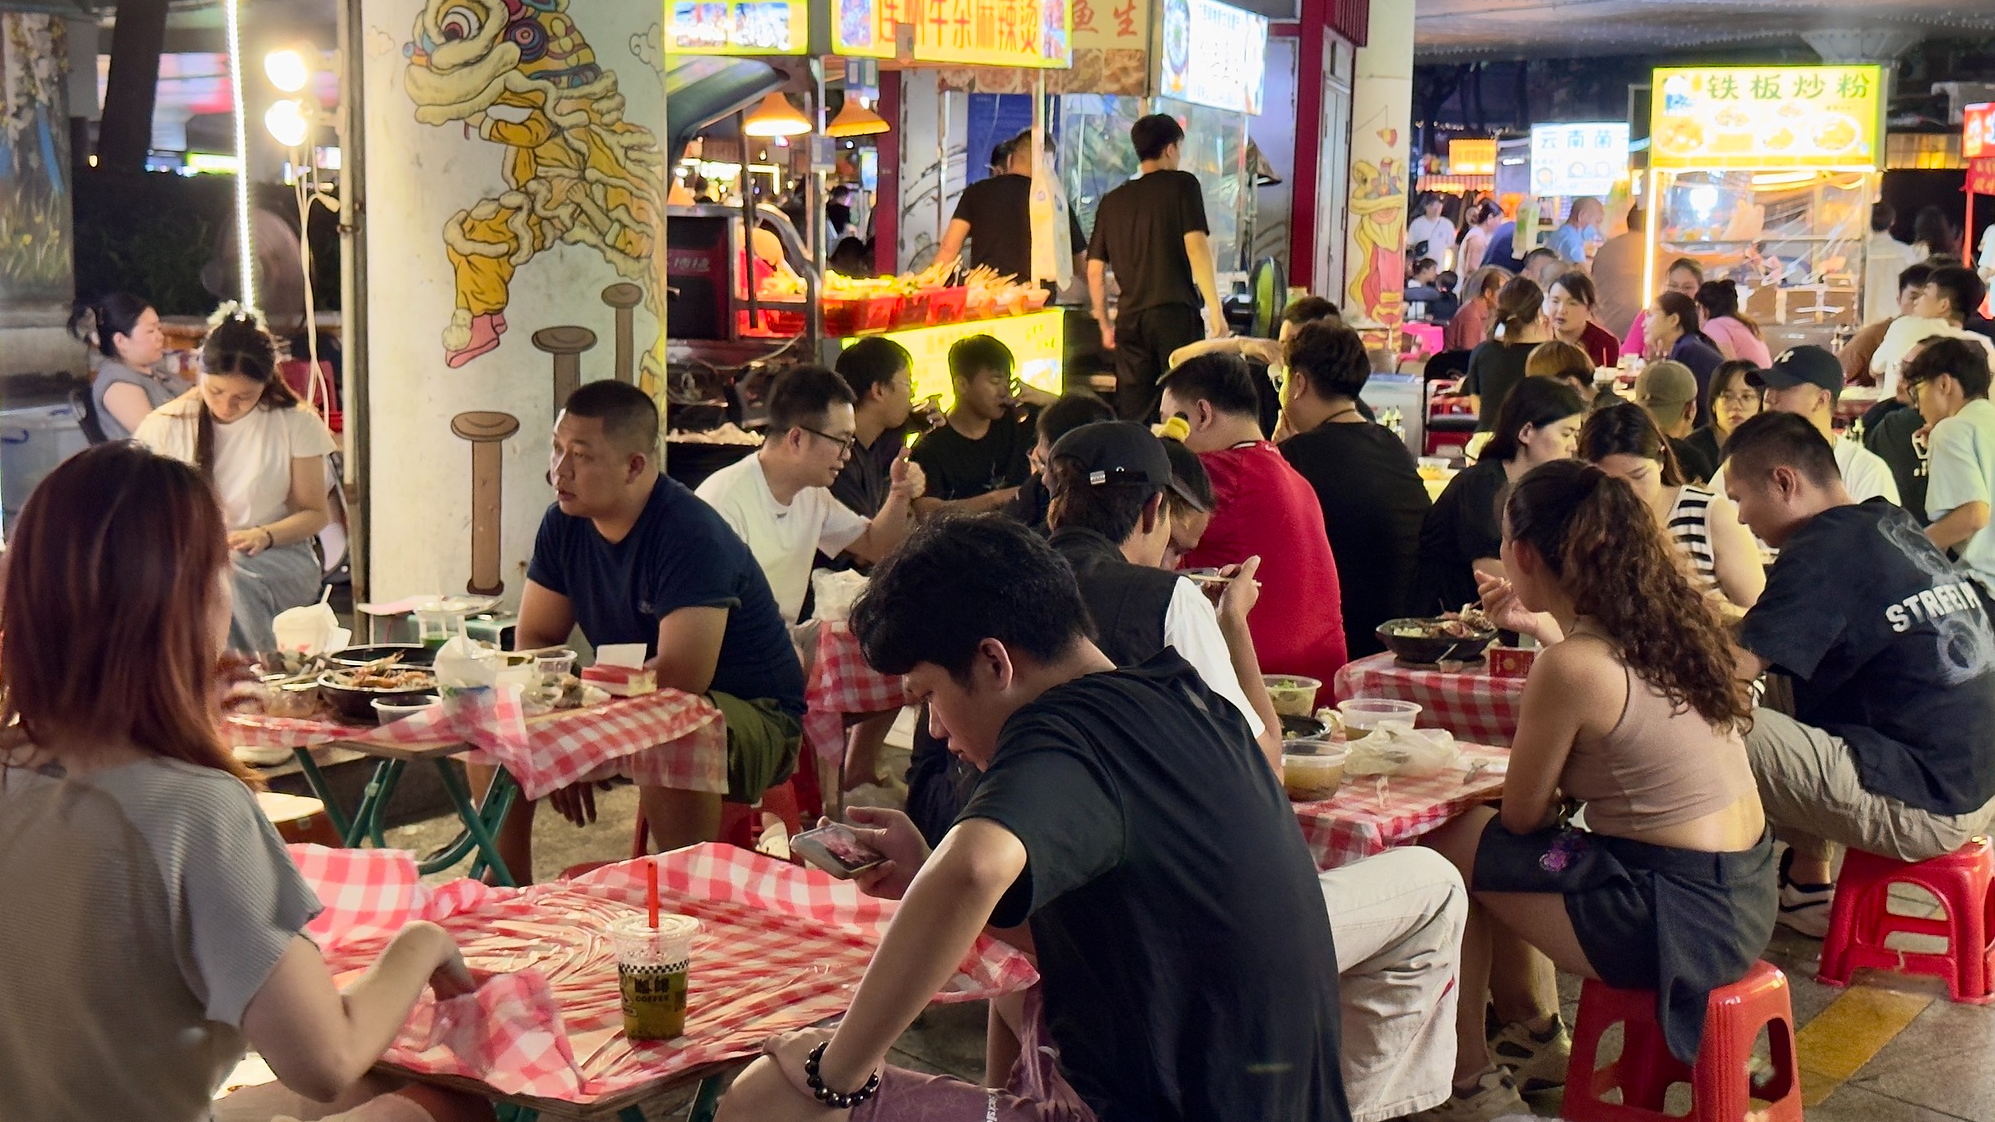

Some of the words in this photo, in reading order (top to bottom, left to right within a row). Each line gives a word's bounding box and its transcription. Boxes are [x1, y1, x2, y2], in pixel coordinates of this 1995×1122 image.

[1707, 73, 1870, 99] 铁板炒粉
[1541, 130, 1629, 148] 云南菌
